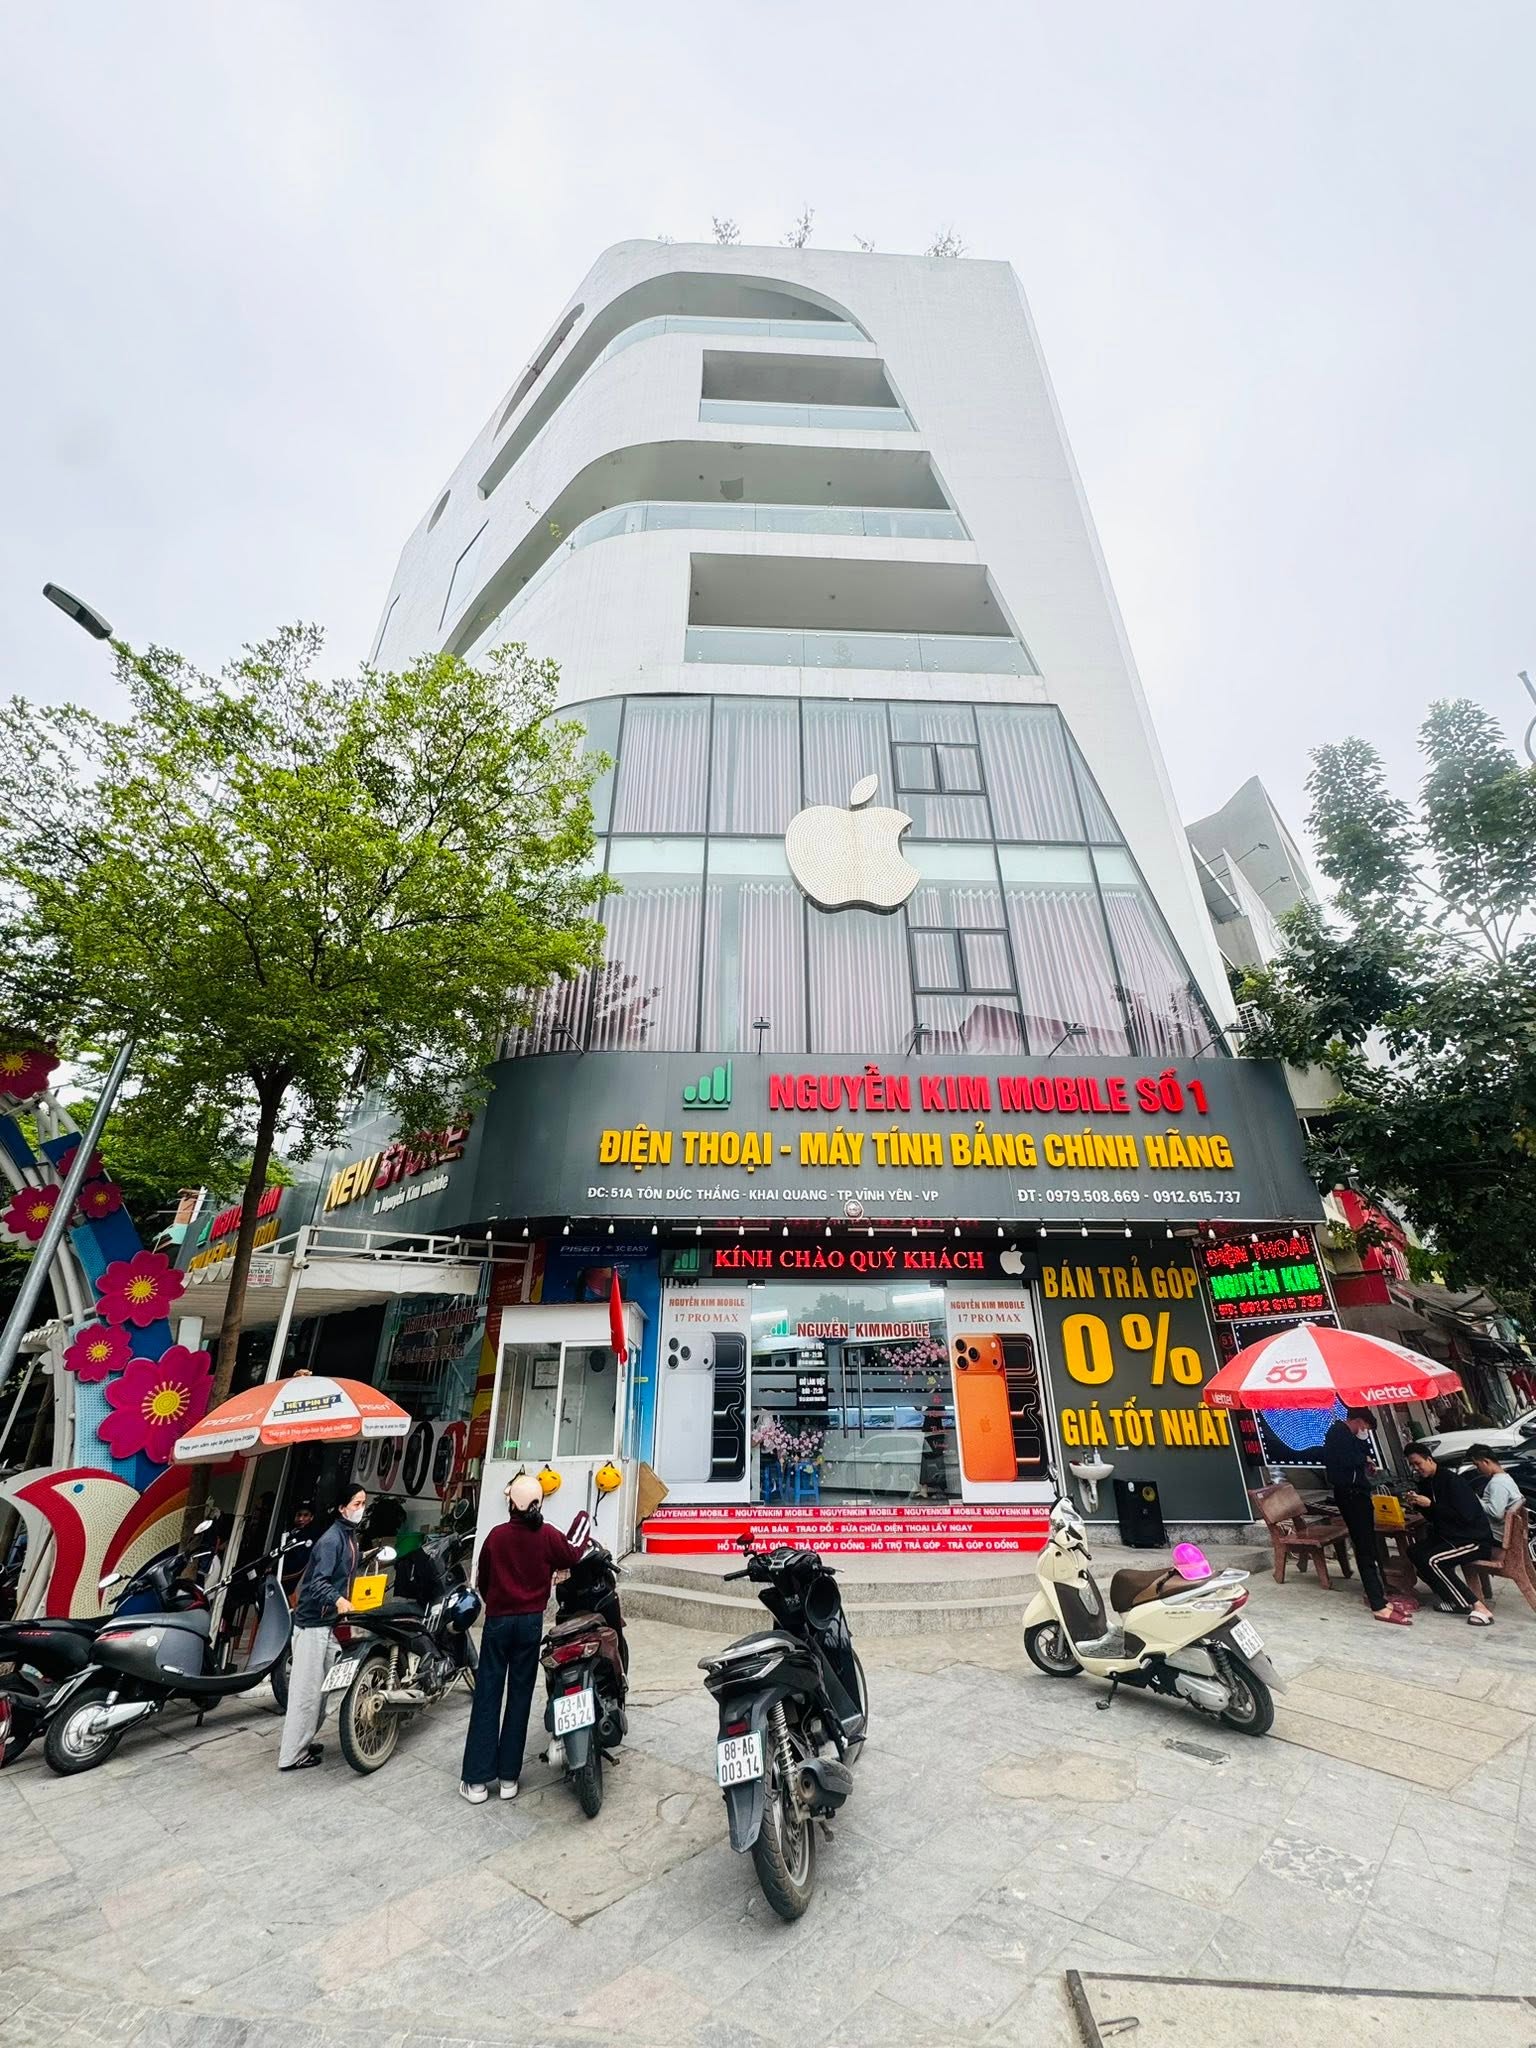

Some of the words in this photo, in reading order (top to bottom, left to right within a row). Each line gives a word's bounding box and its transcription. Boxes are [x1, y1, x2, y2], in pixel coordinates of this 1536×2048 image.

[769, 1063, 911, 1111] NGUYỄN
[920, 1075, 991, 1112] KIM
[998, 1076, 1131, 1113] MOBILE
[1136, 1067, 1184, 1114] SỐ
[1187, 1079, 1209, 1114] 1
[600, 1123, 673, 1172] ĐIỆN
[682, 1131, 773, 1173] THOẠI
[780, 1145, 792, 1155] -
[800, 1125, 865, 1167] MÁY
[872, 1125, 943, 1167] TÍNH
[950, 1121, 1038, 1168] BẢNG
[1044, 1127, 1139, 1168] CHÍNH
[1145, 1127, 1235, 1169] HÃNG
[322, 1152, 382, 1211] NEW
[588, 1187, 609, 1199] ĐC:
[611, 1187, 633, 1199] 51A
[637, 1186, 663, 1199] TÔN
[666, 1185, 692, 1200] ĐỨC
[697, 1184, 740, 1200] THẮNG
[749, 1189, 779, 1200] KHAI
[782, 1190, 827, 1201] QUANG
[837, 1190, 853, 1202] TP
[855, 1187, 885, 1201] VĨNH
[888, 1188, 912, 1201] YÊN
[922, 1190, 939, 1202] VP
[1017, 1189, 1042, 1202] ĐT:
[1046, 1190, 1140, 1203] 0979.508.669
[1153, 1190, 1241, 1204] 0912.615.737
[560, 1245, 601, 1253] PISEN
[715, 1245, 773, 1268] KÍNH
[779, 1245, 845, 1268] CHÀO
[850, 1246, 897, 1272] QUÝ
[904, 1246, 984, 1269] KHÁCH
[1206, 1243, 1249, 1269] ĐIỆN
[1251, 1235, 1310, 1261] THOẠI
[1042, 1259, 1096, 1299] BÁN
[1098, 1255, 1149, 1299] TRẢ
[1151, 1261, 1198, 1300] GÓP
[1210, 1262, 1281, 1300] NGUYỄN
[1280, 1263, 1321, 1292] KIM
[669, 1296, 700, 1307] NGUYỄN
[701, 1298, 715, 1307] KIM
[716, 1298, 745, 1307] MOBILE
[950, 1299, 981, 1310] NGUYỄN
[981, 1301, 996, 1310] KIM
[997, 1301, 1026, 1310] MOBILE
[1272, 1298, 1297, 1311] 615
[1298, 1295, 1323, 1308] 737
[674, 1313, 685, 1322] 17
[688, 1313, 711, 1322] PRO
[713, 1313, 739, 1322] MAX
[958, 1313, 968, 1322] 17
[971, 1313, 993, 1322] PRO
[995, 1313, 1022, 1323] MAX
[855, 1322, 930, 1338] KIMMOBILE
[1062, 1311, 1203, 1386] 0%
[1275, 1356, 1308, 1365] viettel
[1265, 1363, 1308, 1384] 5G
[1211, 1392, 1233, 1405] viettel
[1360, 1383, 1417, 1402] viettel
[305, 1399, 320, 1409] PIN
[201, 1413, 253, 1428] PISEN
[1061, 1401, 1109, 1448] GIÁ
[1110, 1395, 1156, 1448] TỐT
[700, 1508, 728, 1517] MOBILE
[735, 1508, 782, 1517] NGUYENKIM
[785, 1508, 813, 1517] MOBILE
[820, 1508, 866, 1517] NGUYENKIM
[868, 1508, 897, 1516] MOBILE
[904, 1507, 951, 1516] NGUYENKIM
[953, 1507, 981, 1516] MOBILE
[983, 1507, 1030, 1516] NGUYENKIM
[750, 1525, 769, 1533] MUA
[771, 1524, 789, 1533] BÁN
[819, 1522, 834, 1533] ĐỔI
[841, 1522, 858, 1532] SỬA
[859, 1523, 882, 1532] CHỮA
[884, 1523, 903, 1534] ĐIỆN
[905, 1524, 929, 1534] THOẠI
[931, 1521, 948, 1532] LẤY
[950, 1524, 973, 1532] NGAY
[751, 1540, 767, 1550] TRẢ
[769, 1539, 788, 1550] GÓP
[794, 1539, 811, 1550] TRẢ
[813, 1539, 831, 1550] GÓP
[840, 1539, 865, 1550] ĐỒNG
[885, 1540, 902, 1551] TRỢ
[904, 1539, 921, 1549] TRẢ
[923, 1539, 941, 1549] GÓP
[949, 1538, 965, 1549] TRẢ
[966, 1539, 984, 1549] GÓP
[993, 1538, 1019, 1549] ĐỒNG
[557, 1709, 592, 1732] 053.24
[724, 1737, 754, 1761] 88-AG
[721, 1762, 760, 1783] 003.14
